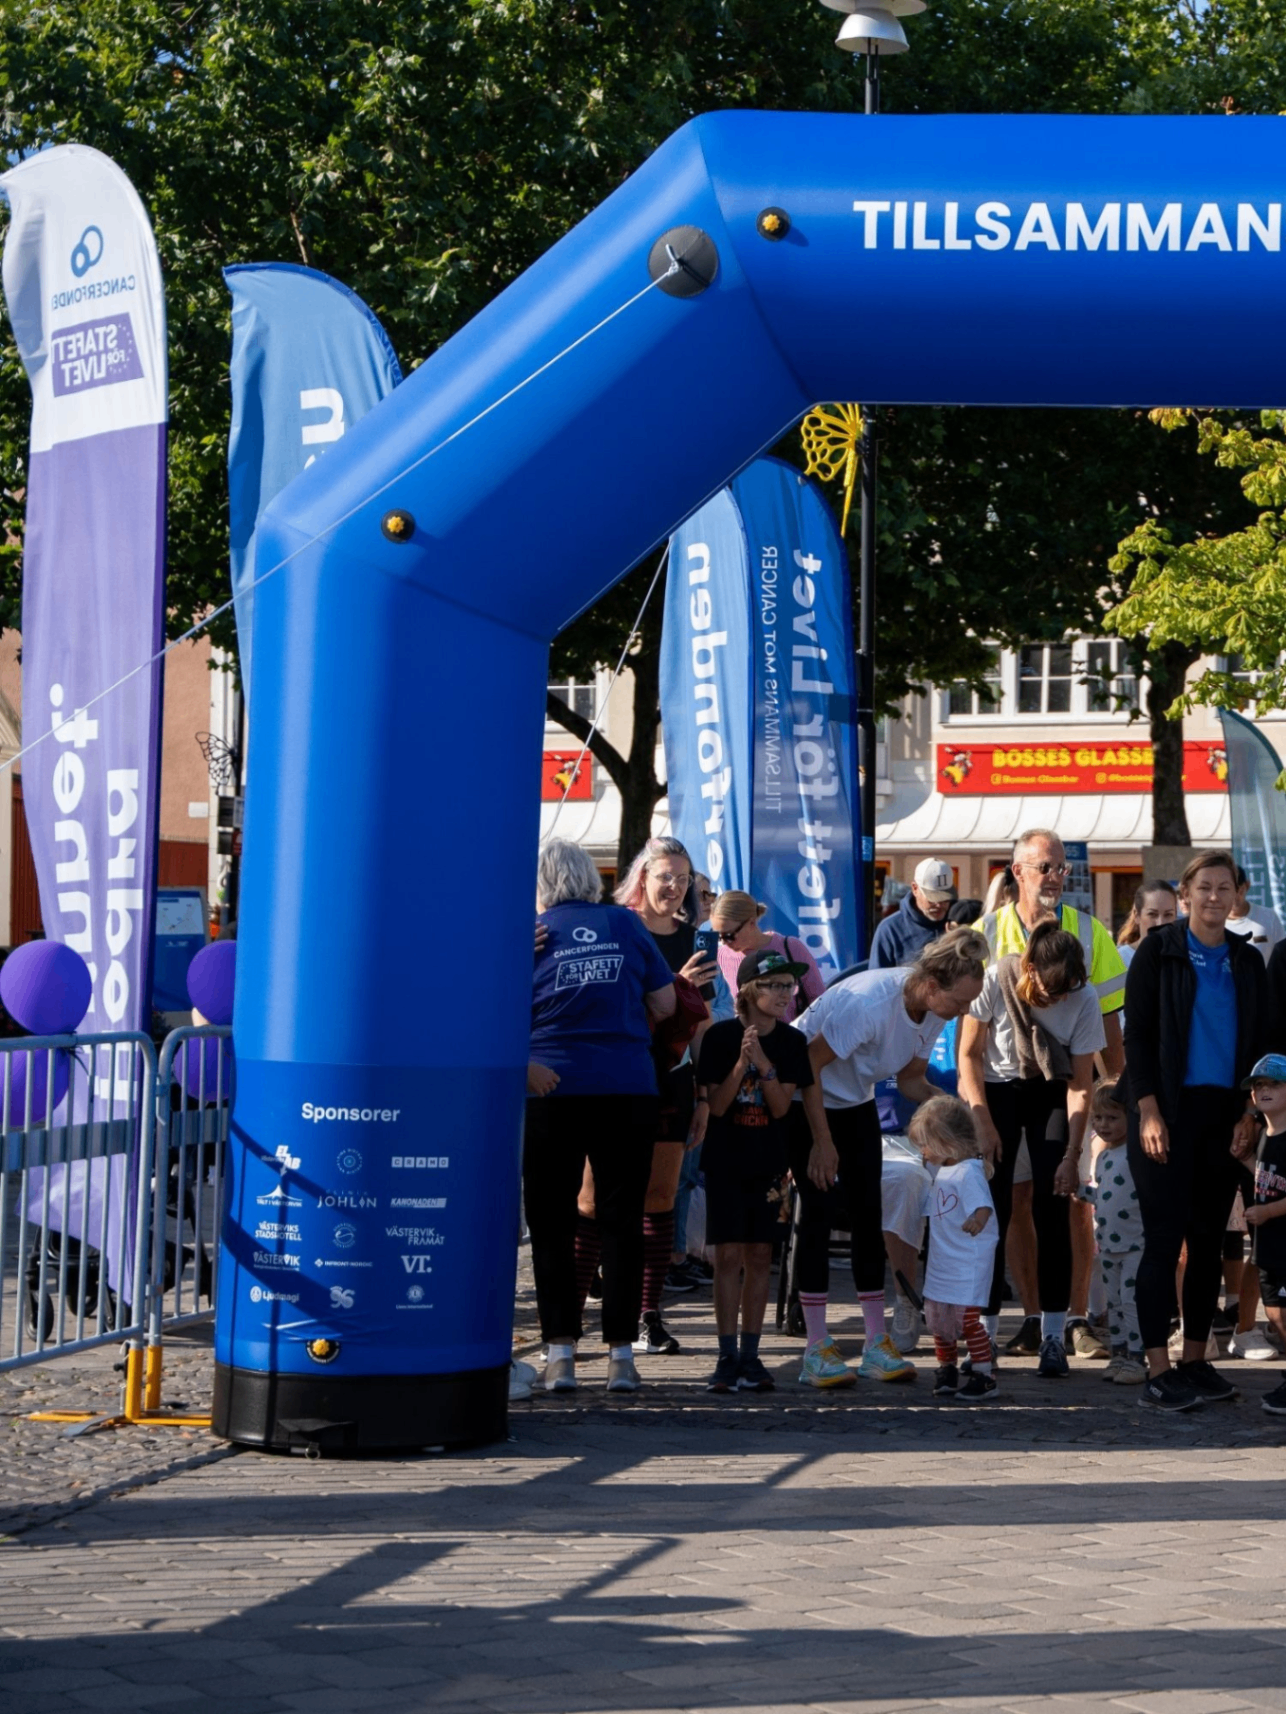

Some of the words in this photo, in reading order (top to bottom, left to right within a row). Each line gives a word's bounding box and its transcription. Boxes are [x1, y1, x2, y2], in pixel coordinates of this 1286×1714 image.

[993, 749, 1072, 768] BOSSES
[553, 942, 620, 958] CANCERFONDEN
[569, 958, 620, 973] STAFETT
[579, 968, 611, 982] LIVET
[301, 1102, 400, 1123] Sponsorer
[392, 1157, 449, 1168] CRAMO
[259, 1221, 299, 1232] VÄSTERVIKS
[385, 1225, 435, 1237] VÄSTERVIK
[255, 1230, 302, 1241] STADSHOTELL
[408, 1233, 445, 1246] FRAMÅT
[253, 1251, 301, 1267] VÄSTERVIK
[400, 1255, 432, 1274] VT.
[262, 1290, 300, 1303] Ljudmagi
